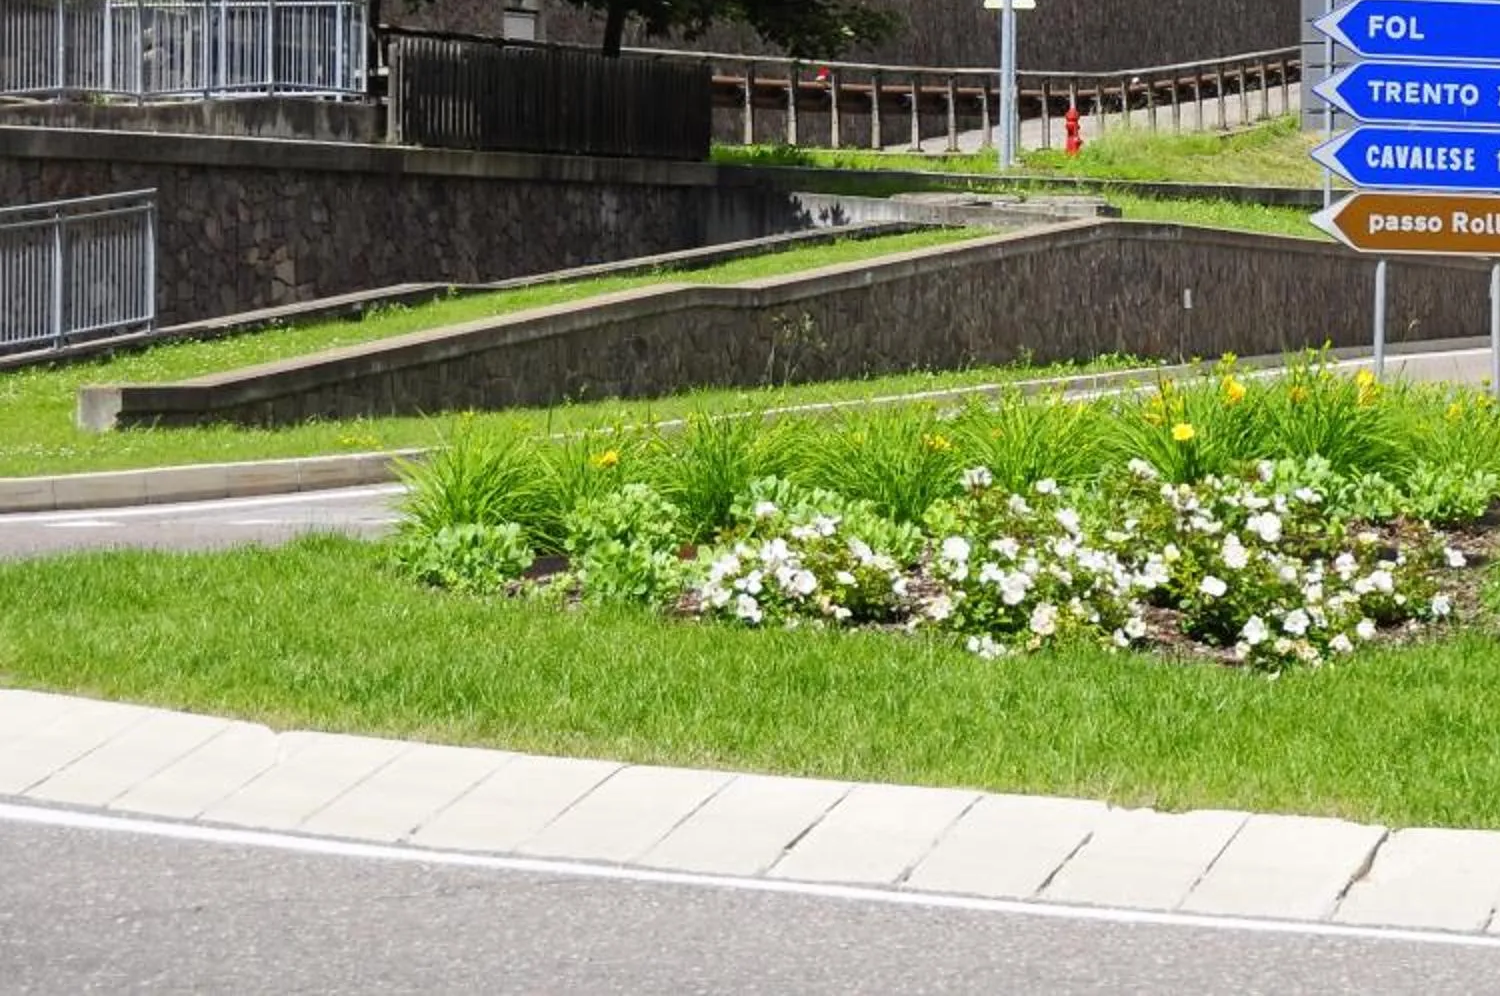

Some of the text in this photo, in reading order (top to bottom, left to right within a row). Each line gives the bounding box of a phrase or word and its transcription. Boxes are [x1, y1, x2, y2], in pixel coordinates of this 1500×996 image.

[1368, 14, 1424, 40] FOL
[1367, 79, 1480, 106] TRENTO
[1366, 144, 1476, 172] CAVALESE
[1368, 212, 1442, 235] passo
